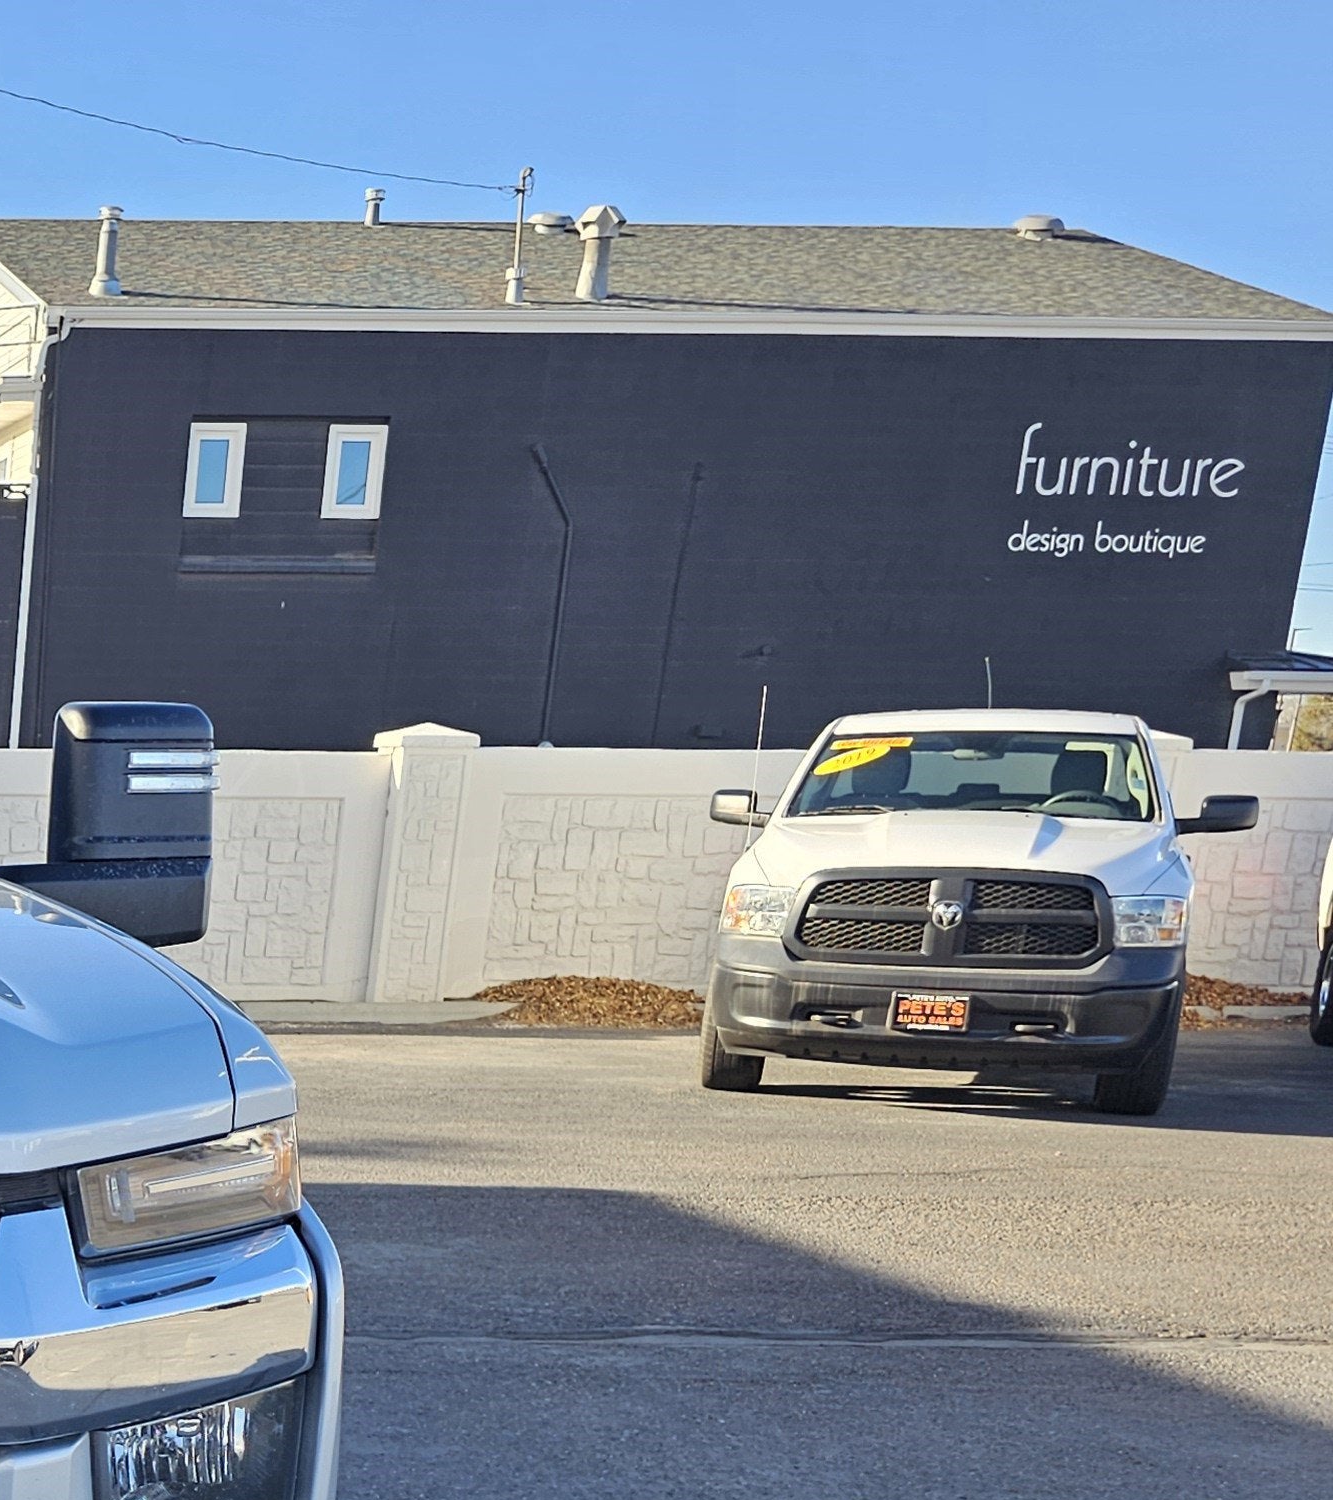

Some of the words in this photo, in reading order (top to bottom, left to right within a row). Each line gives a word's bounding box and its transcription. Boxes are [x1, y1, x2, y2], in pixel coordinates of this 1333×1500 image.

[1015, 421, 1245, 498] furniture
[1007, 519, 1085, 558] design
[1093, 520, 1206, 558] boutique
[897, 1014, 926, 1024] AUTO
[928, 1015, 963, 1026] SALES
[898, 1000, 965, 1017] PETE'S
